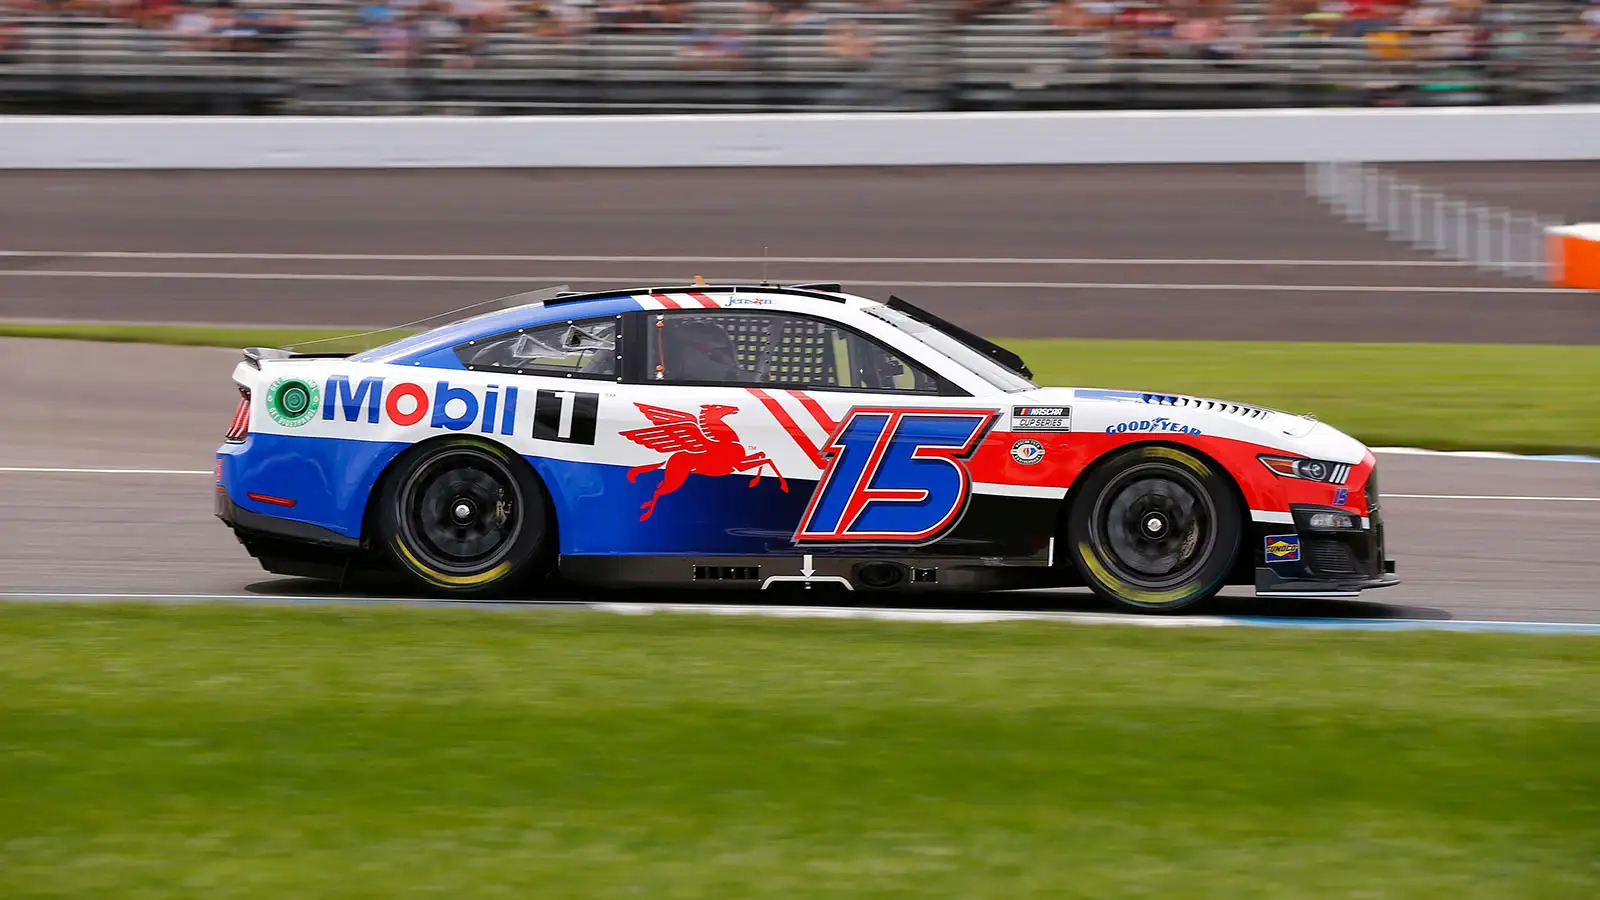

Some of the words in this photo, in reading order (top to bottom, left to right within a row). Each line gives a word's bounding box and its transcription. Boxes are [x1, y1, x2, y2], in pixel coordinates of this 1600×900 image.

[322, 375, 518, 436] Mobil
[1031, 408, 1064, 416] NASCAR
[1019, 418, 1035, 427] CUP
[1035, 419, 1063, 427] SERIES
[792, 405, 1003, 547] 15
[1332, 488, 1349, 506] 15
[1265, 543, 1299, 553] SUNOCO
